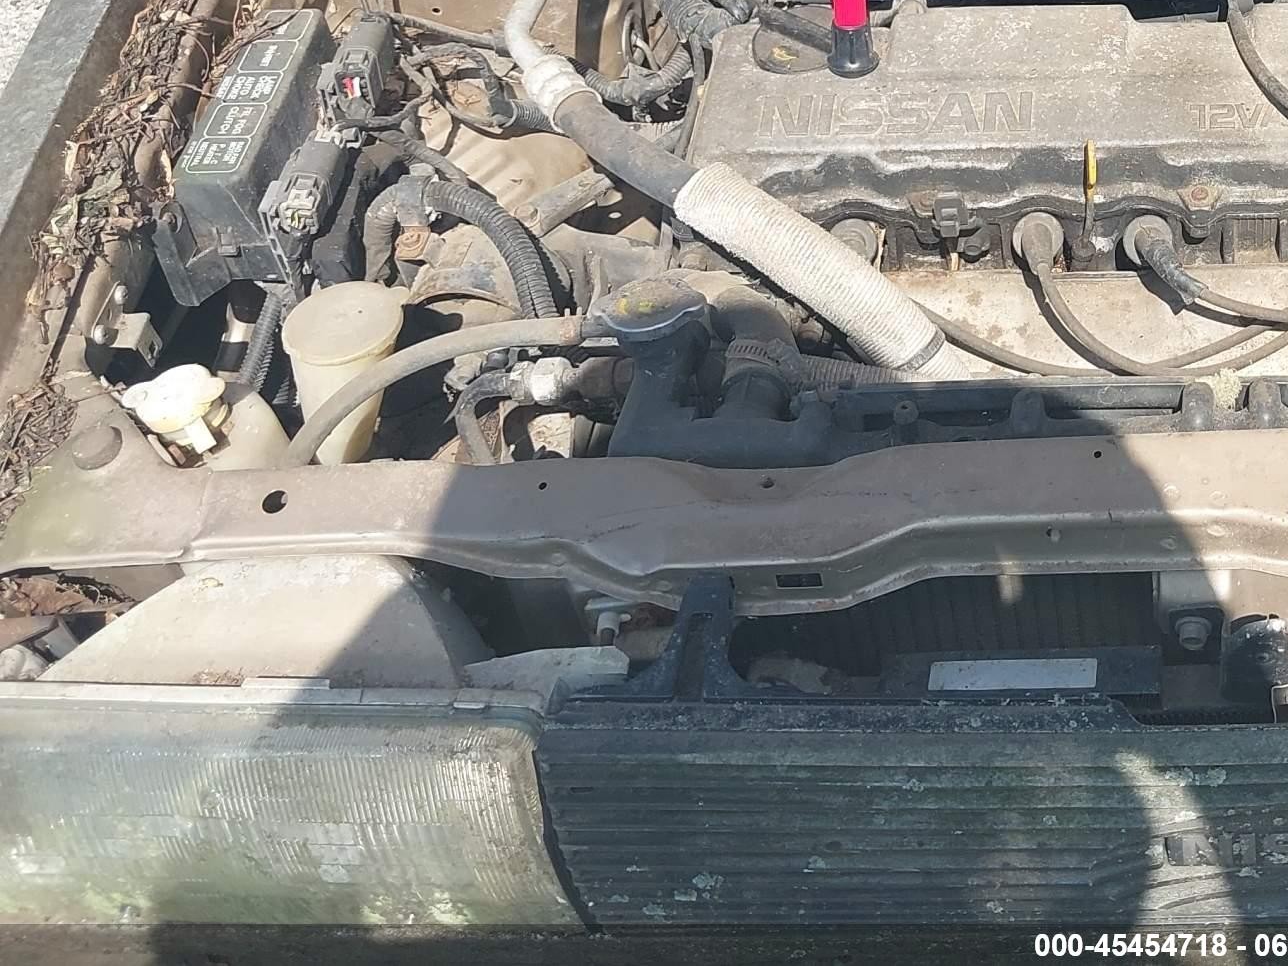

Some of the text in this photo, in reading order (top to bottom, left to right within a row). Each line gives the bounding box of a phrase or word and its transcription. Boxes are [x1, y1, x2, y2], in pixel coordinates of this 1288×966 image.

[226, 76, 247, 100] CHOKE
[239, 76, 255, 95] AUTO
[249, 75, 268, 99] CHECK
[262, 75, 278, 95] LAMP
[216, 106, 239, 134] CLUTCH
[756, 91, 1034, 137] NISSAN
[230, 119, 246, 134] FOG
[189, 141, 209, 167] NEUTRAL
